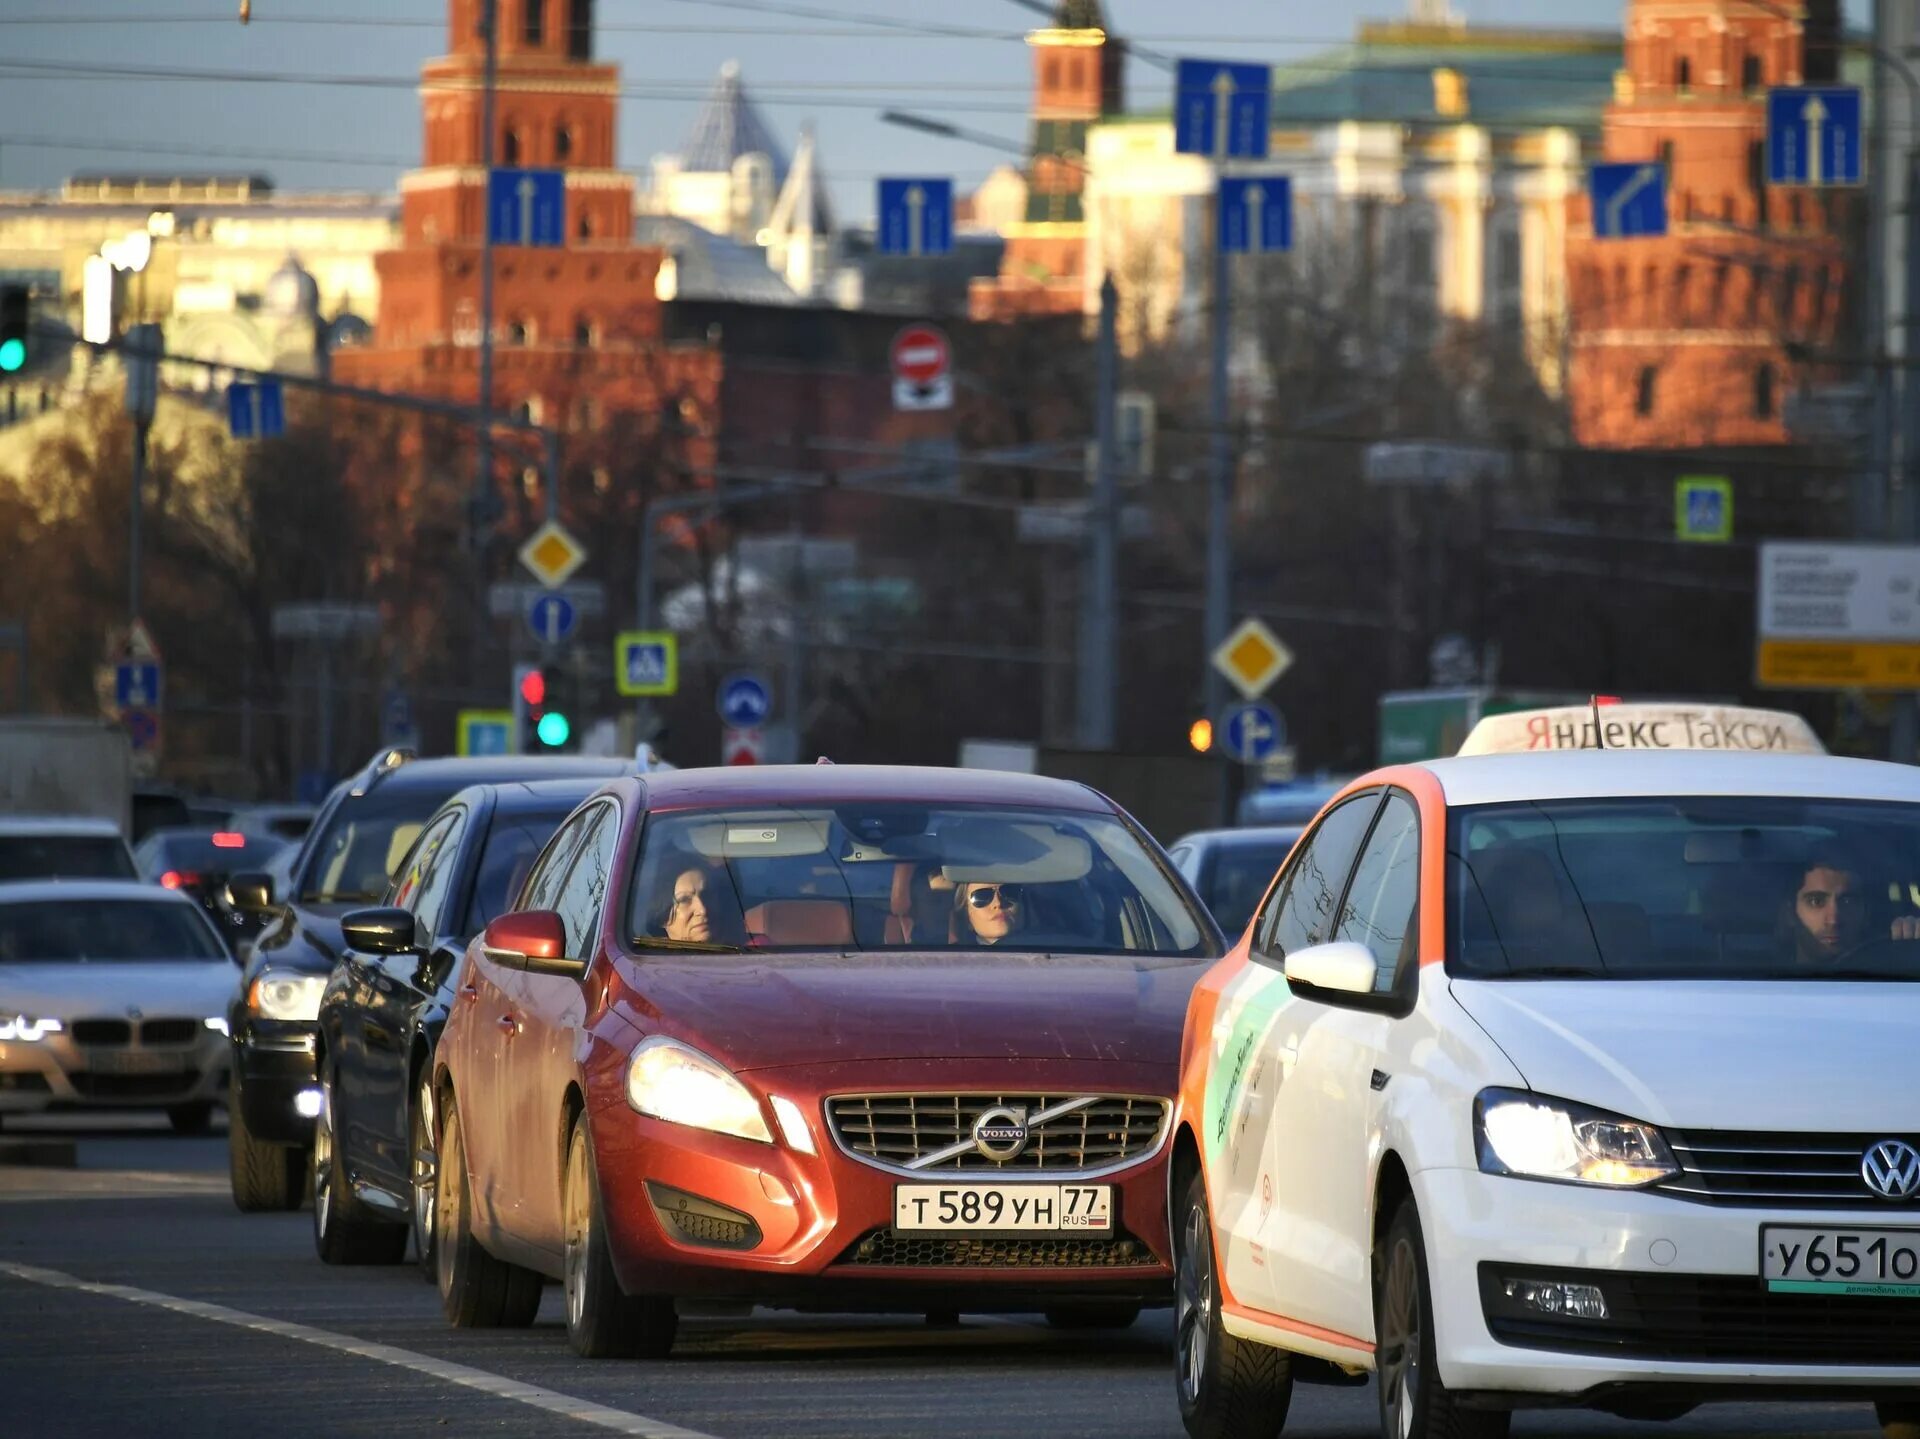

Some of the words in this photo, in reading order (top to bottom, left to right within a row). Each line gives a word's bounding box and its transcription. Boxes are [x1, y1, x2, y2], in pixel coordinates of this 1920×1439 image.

[1527, 715, 1670, 749] Яндекс
[1674, 712, 1787, 750] Такси
[979, 1130, 1024, 1138] VOLVO
[1064, 1188, 1099, 1215] 77
[1062, 1215, 1088, 1226] RUS
